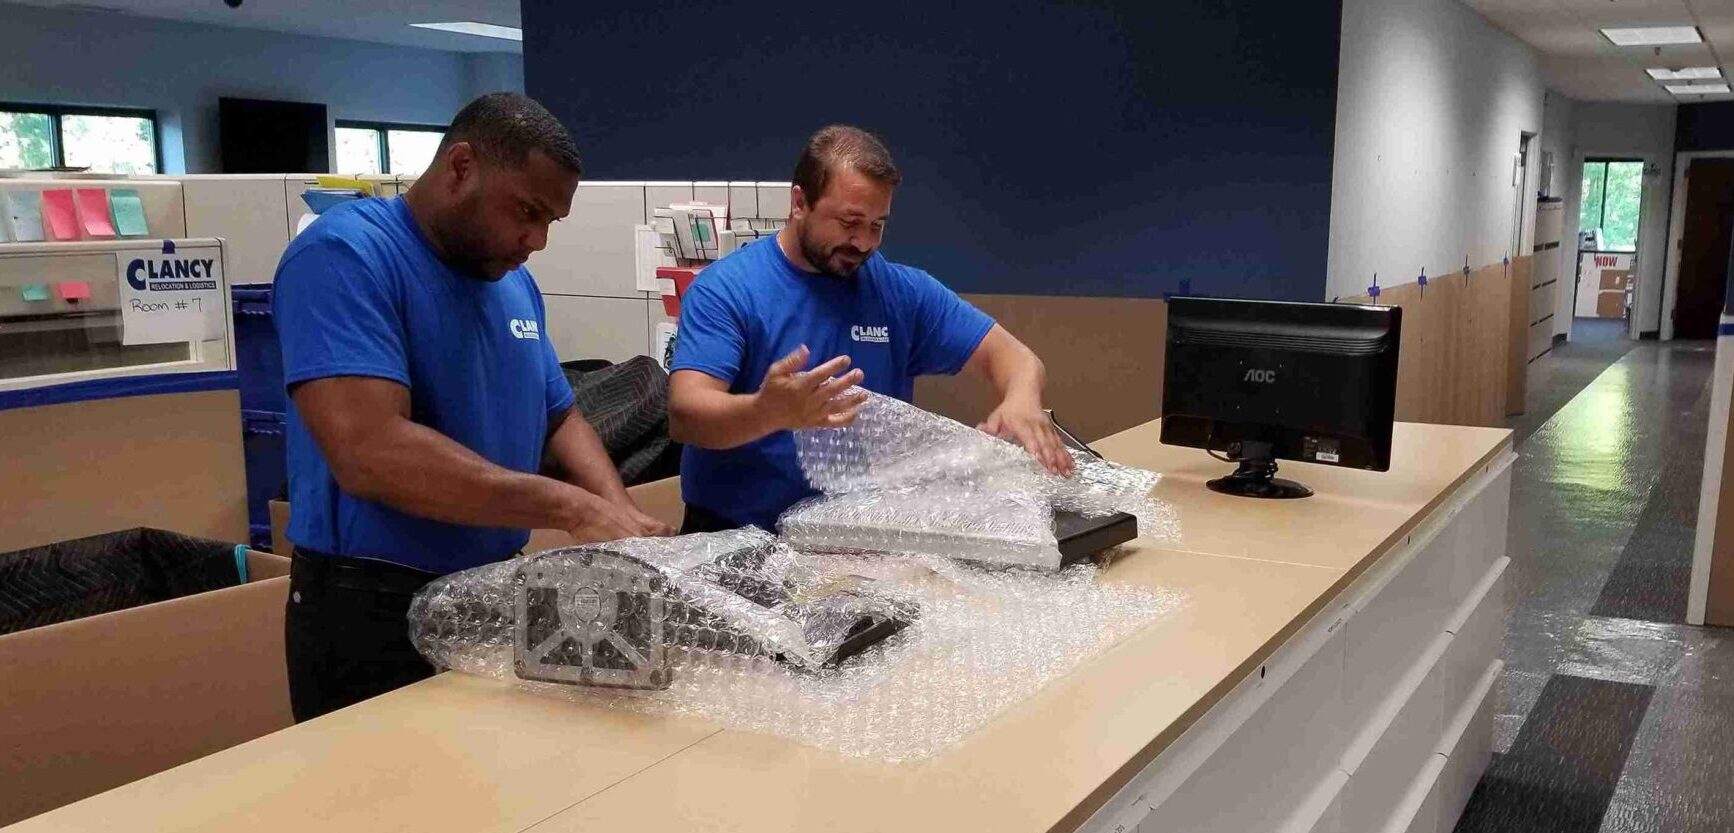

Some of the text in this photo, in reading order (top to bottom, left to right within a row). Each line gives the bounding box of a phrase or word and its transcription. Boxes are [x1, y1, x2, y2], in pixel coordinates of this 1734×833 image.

[127, 259, 213, 290] CLANCY
[151, 282, 184, 291] RELOCATION
[189, 281, 216, 289] LOGISTICS
[175, 300, 188, 310] #
[192, 298, 202, 312] 7
[1243, 369, 1275, 383] AOC
